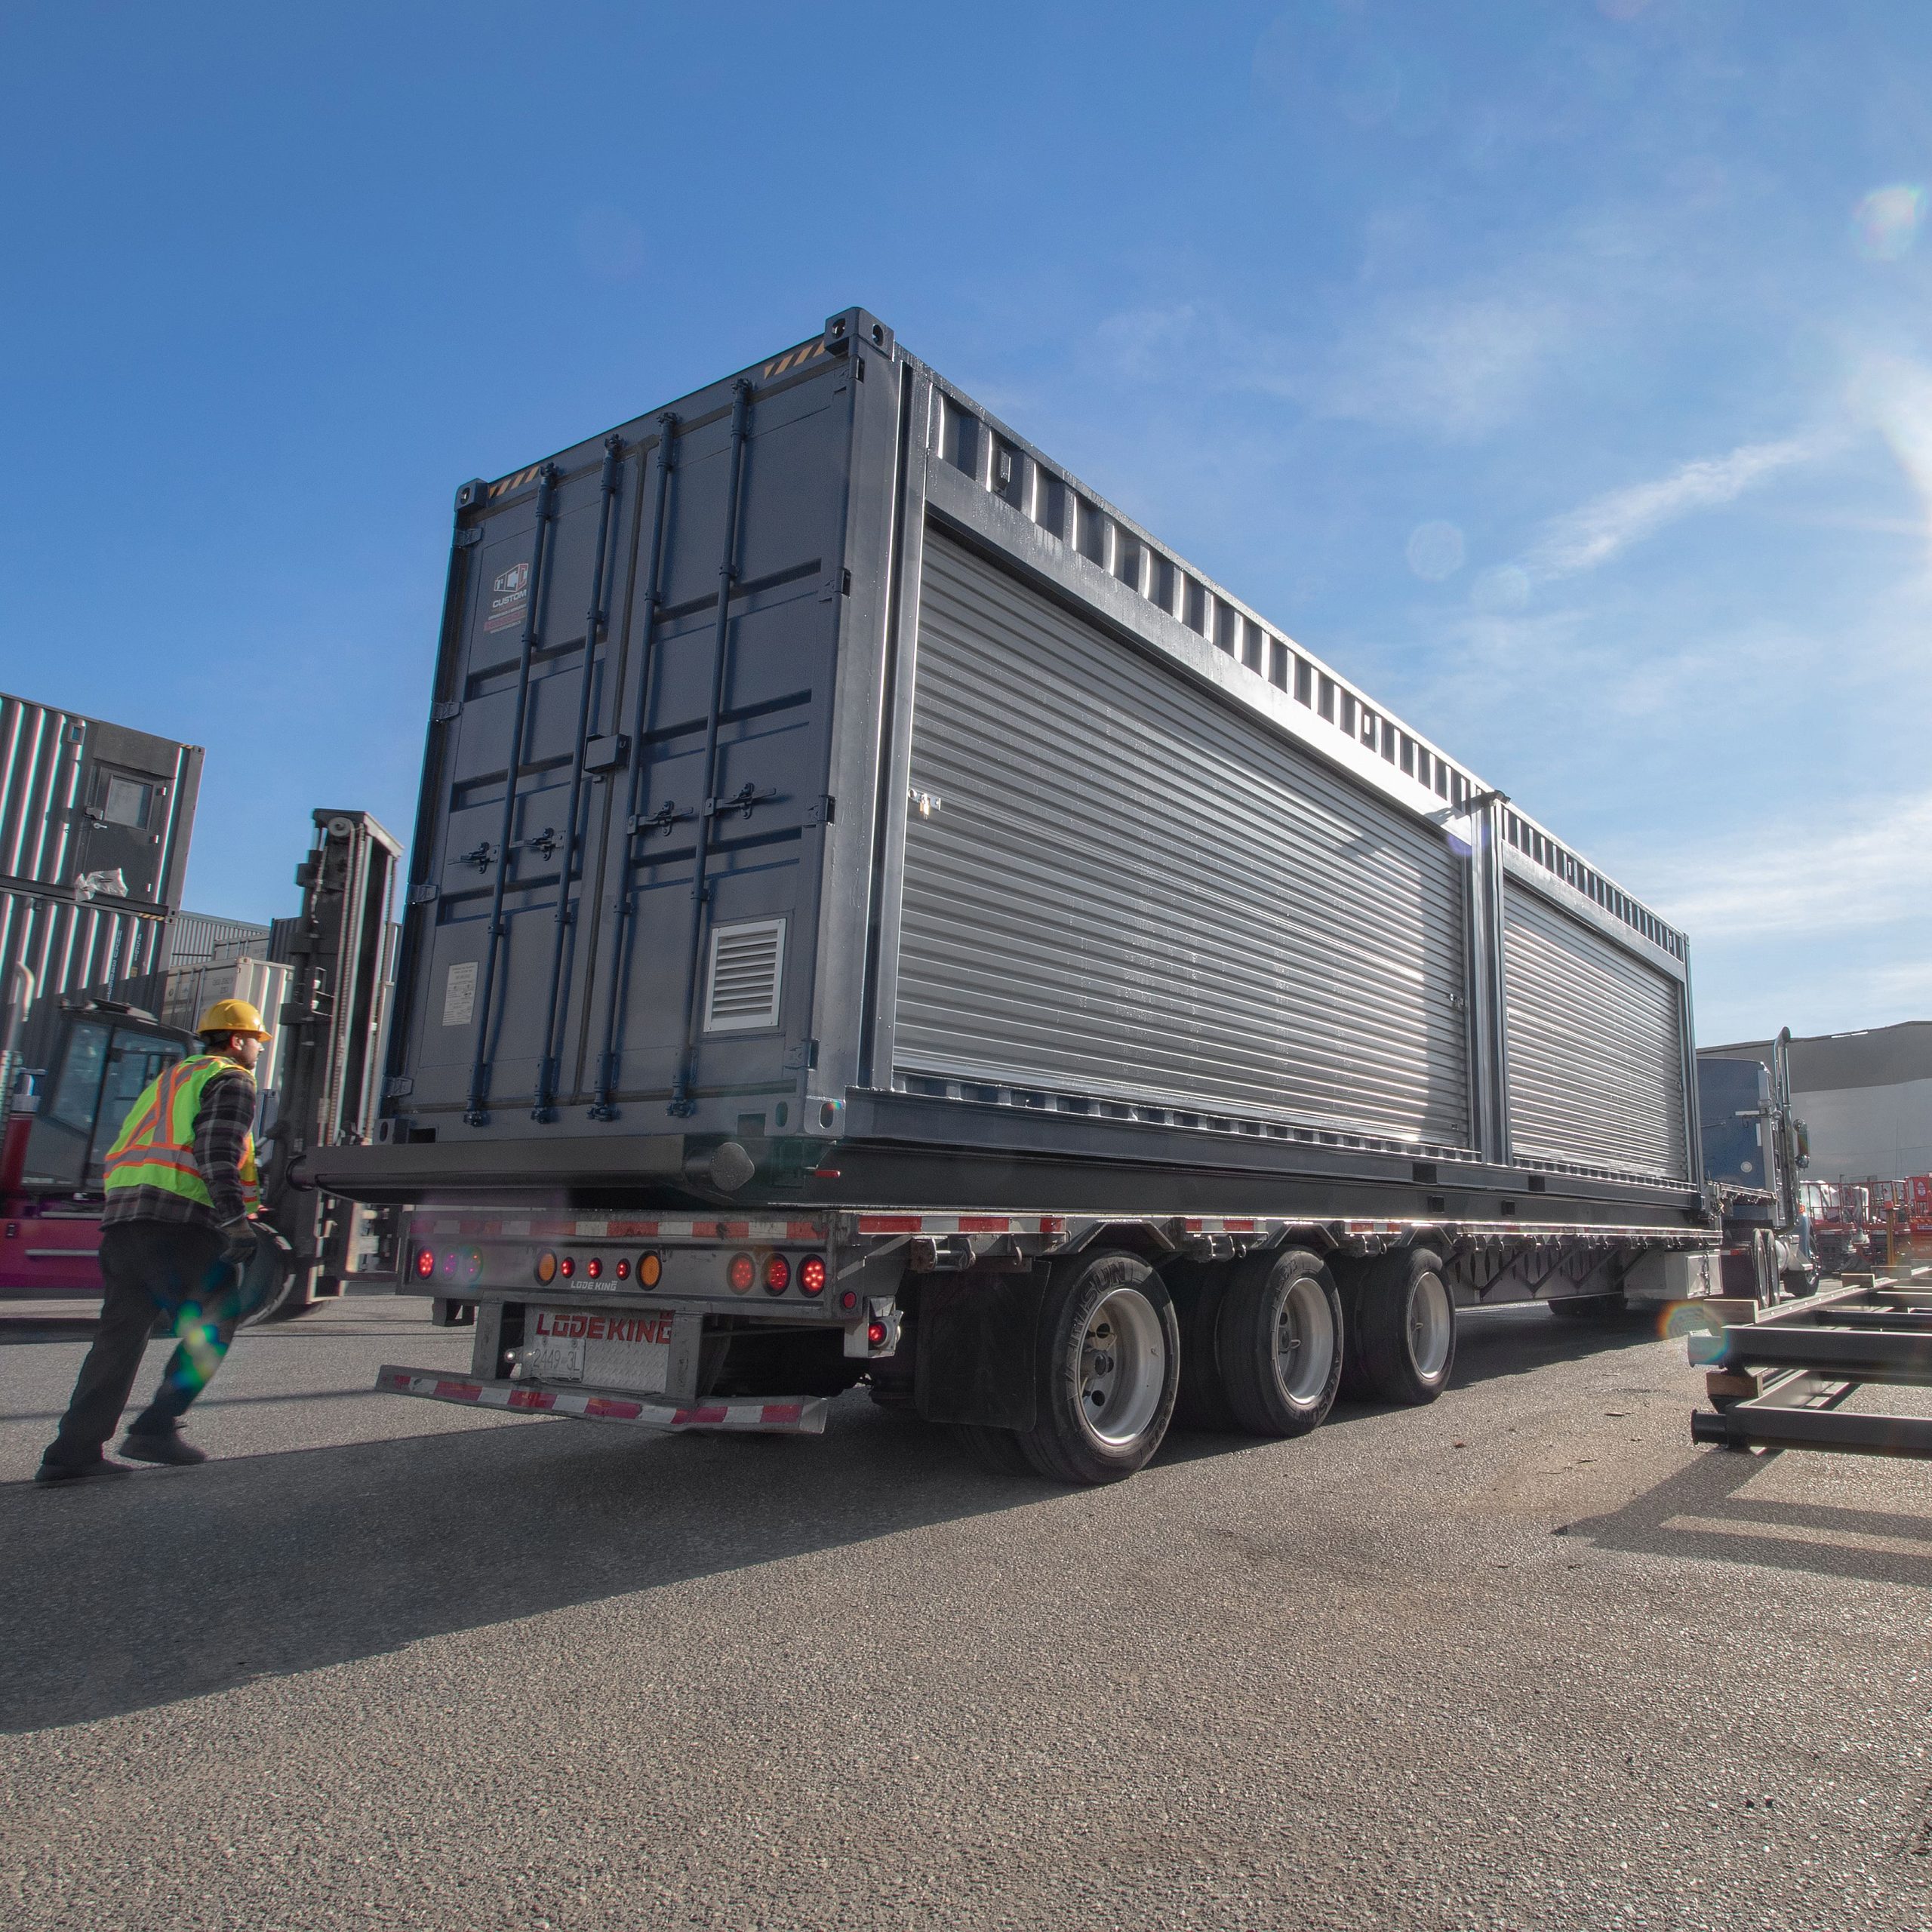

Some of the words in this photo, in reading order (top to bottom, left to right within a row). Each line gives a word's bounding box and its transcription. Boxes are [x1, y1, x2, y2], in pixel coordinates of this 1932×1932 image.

[493, 589, 527, 608] CUSTOM
[571, 1281, 595, 1290] LODE
[595, 1281, 618, 1291] KING
[536, 1313, 607, 1340] LODE
[607, 1310, 675, 1344] KING
